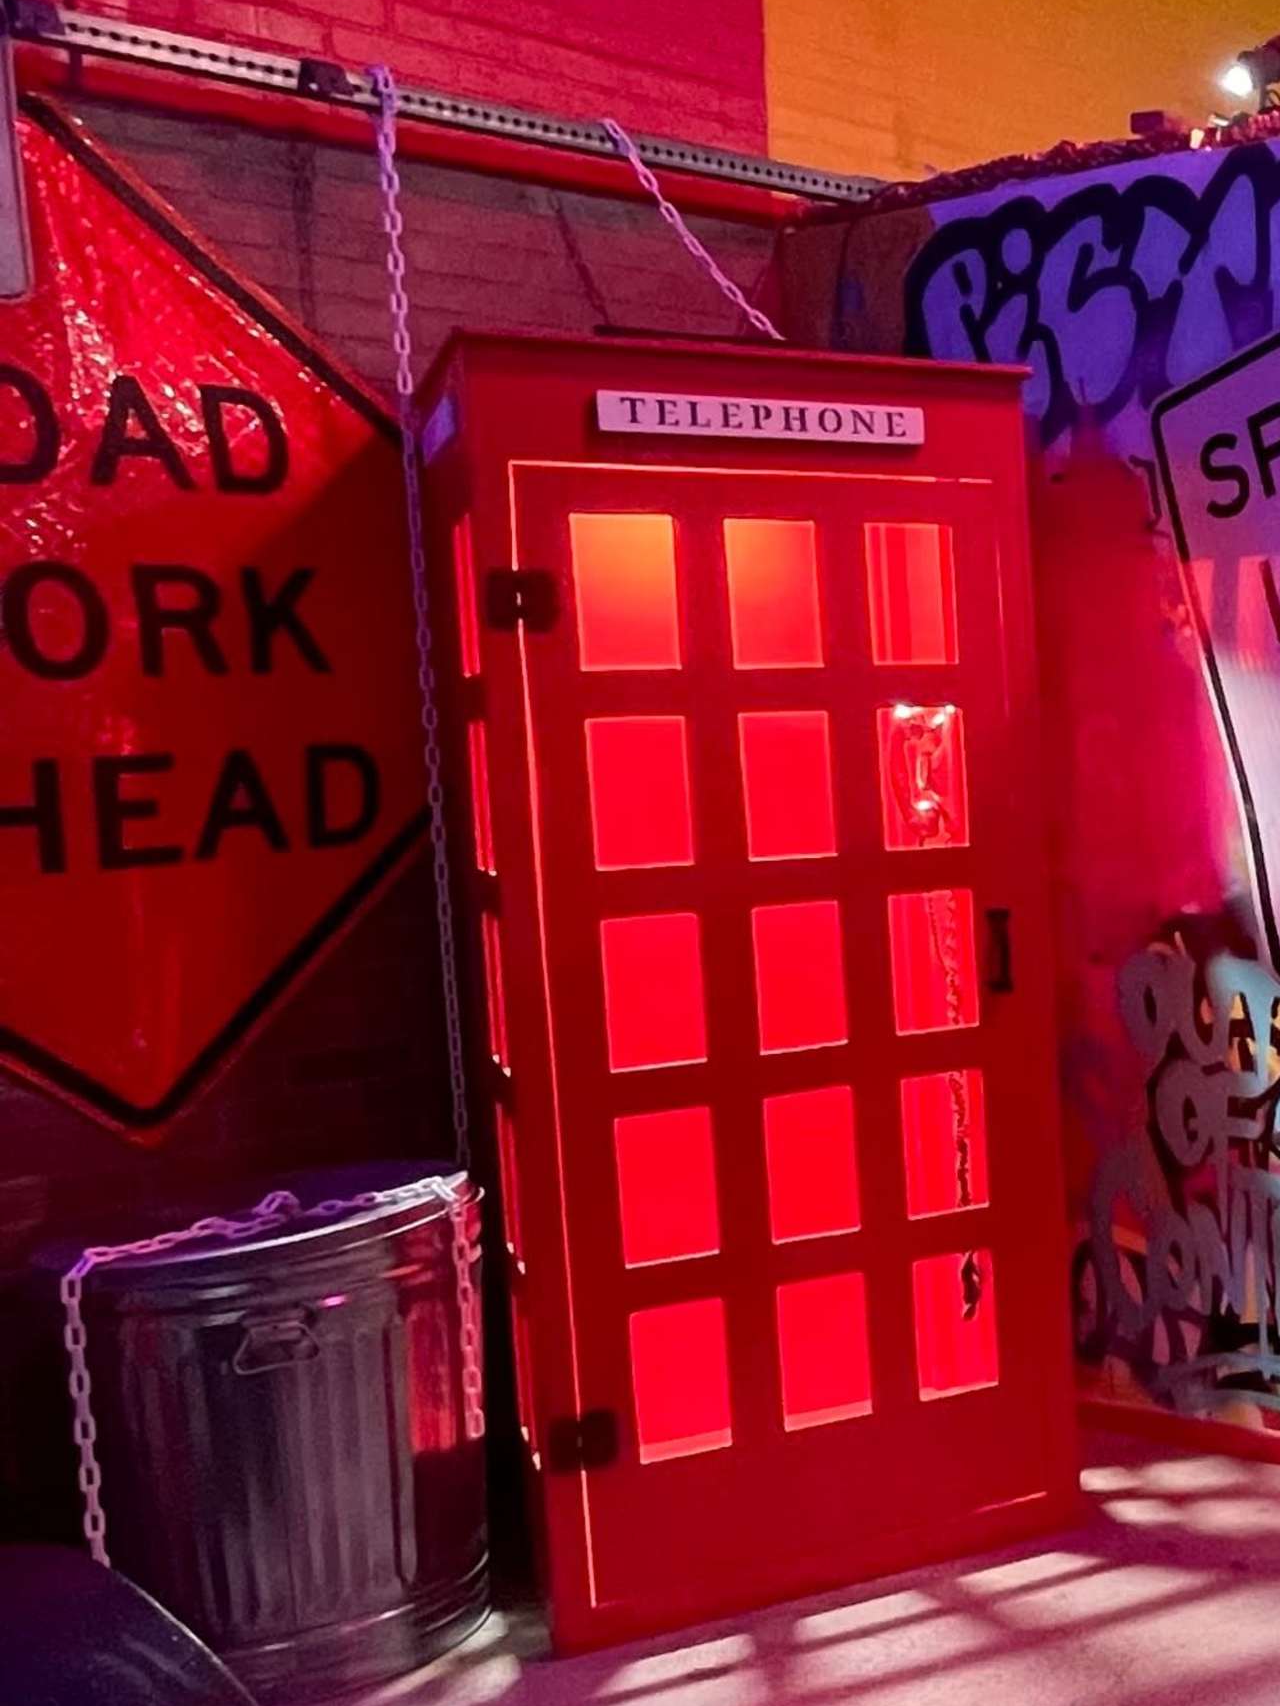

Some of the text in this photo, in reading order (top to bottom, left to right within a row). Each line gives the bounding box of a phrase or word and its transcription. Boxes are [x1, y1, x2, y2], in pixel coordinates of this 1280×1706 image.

[0, 363, 289, 496] OAD
[620, 396, 907, 437] TELEPHONE
[1, 560, 333, 680] ORK
[0, 743, 381, 875] HEAD
